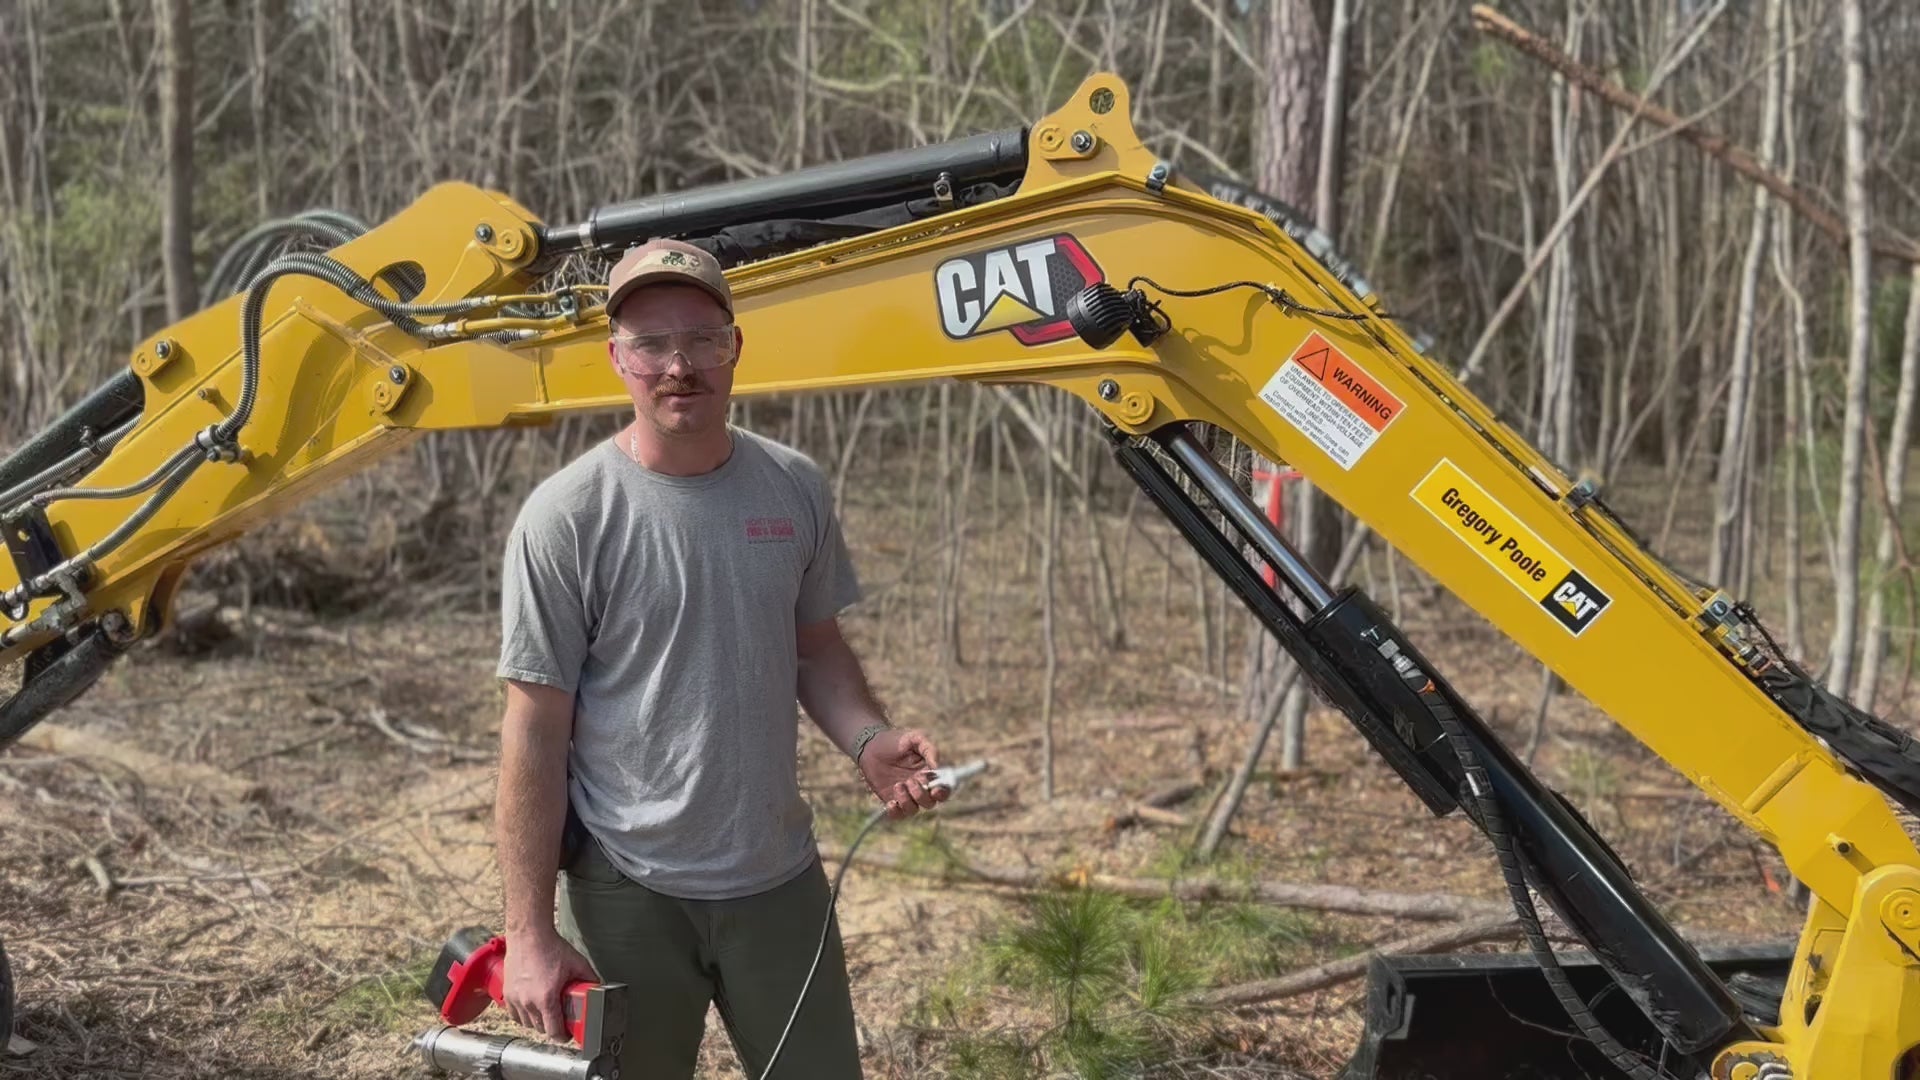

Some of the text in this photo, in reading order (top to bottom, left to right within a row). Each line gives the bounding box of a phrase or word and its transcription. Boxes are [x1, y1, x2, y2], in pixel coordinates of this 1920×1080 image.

[936, 238, 1056, 336] CAT
[1271, 389, 1350, 457] Contact with power lines can
[1278, 375, 1289, 385] OF
[1287, 383, 1321, 413] OVERHEAD
[1278, 405, 1287, 414] in
[1285, 411, 1303, 427] death
[1301, 424, 1309, 433] or
[1308, 430, 1330, 450] serious
[1284, 370, 1368, 442] EQUIPMENT WITHIN TEN FEET
[1289, 365, 1373, 436] UNLAWFUL TO OPERATE THIS
[1332, 367, 1392, 420] WARNING
[1441, 487, 1547, 582] Gregory Poole
[1552, 581, 1599, 620] CAT
